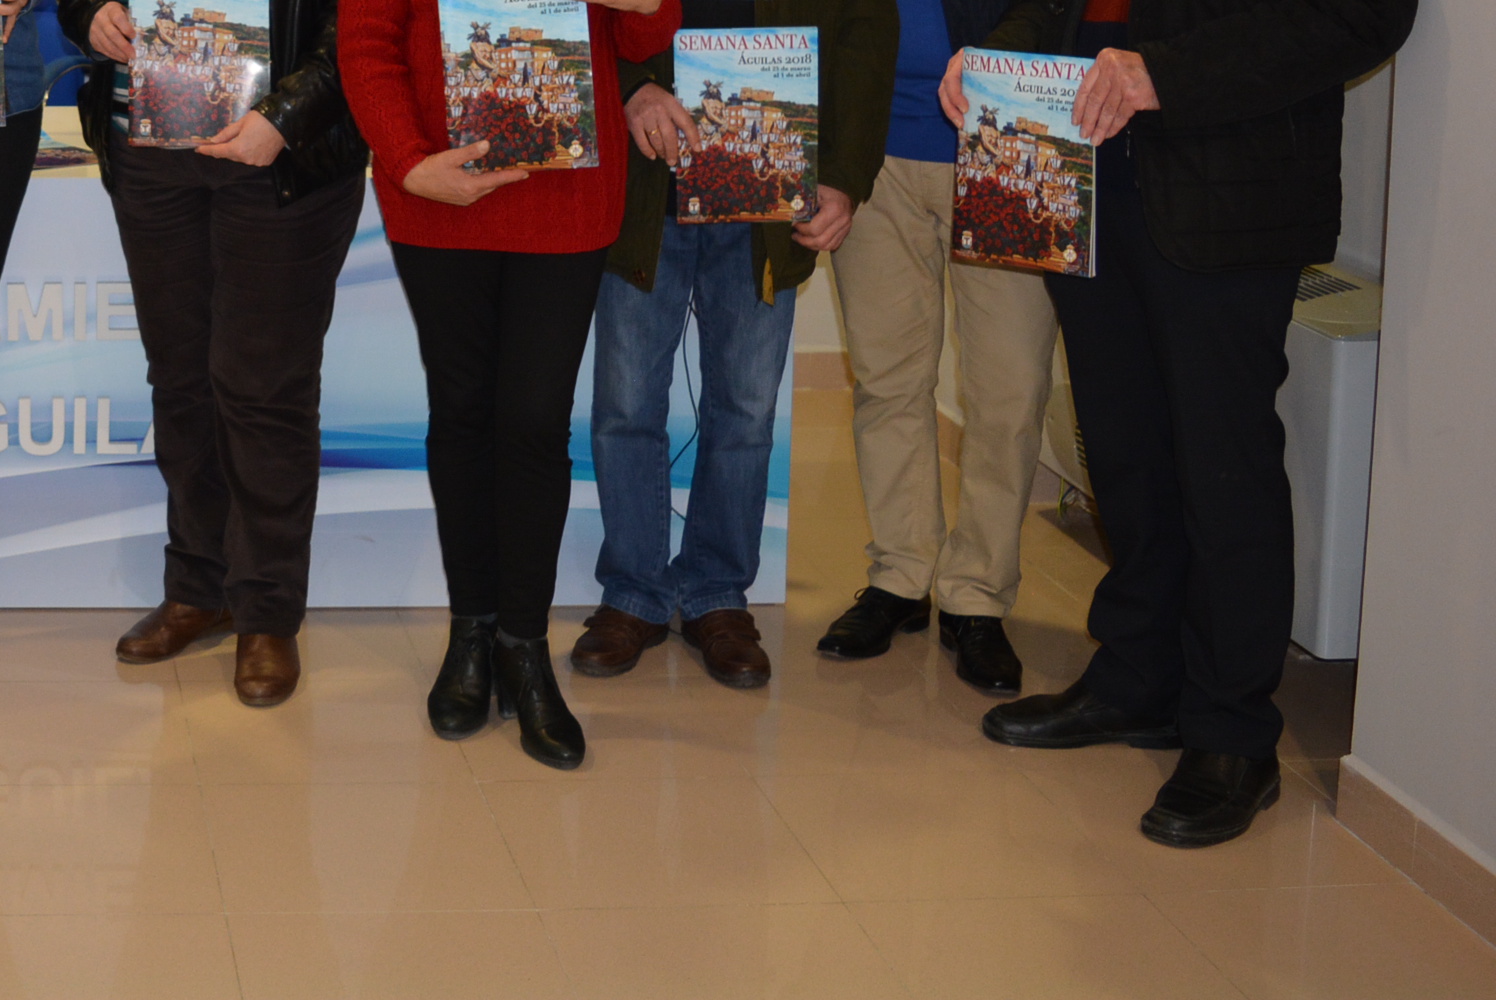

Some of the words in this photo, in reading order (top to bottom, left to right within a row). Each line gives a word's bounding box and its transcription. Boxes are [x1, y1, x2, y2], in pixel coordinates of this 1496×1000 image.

[679, 35, 749, 51] SEMANA
[753, 33, 809, 49] SANTA
[738, 52, 782, 65] ÁGUILAS
[785, 53, 812, 64] 2018
[964, 54, 1026, 76] SEMANA
[1030, 60, 1086, 80] SANTA
[1014, 77, 1057, 96] ÁGUILAS
[1060, 88, 1078, 97] 20
